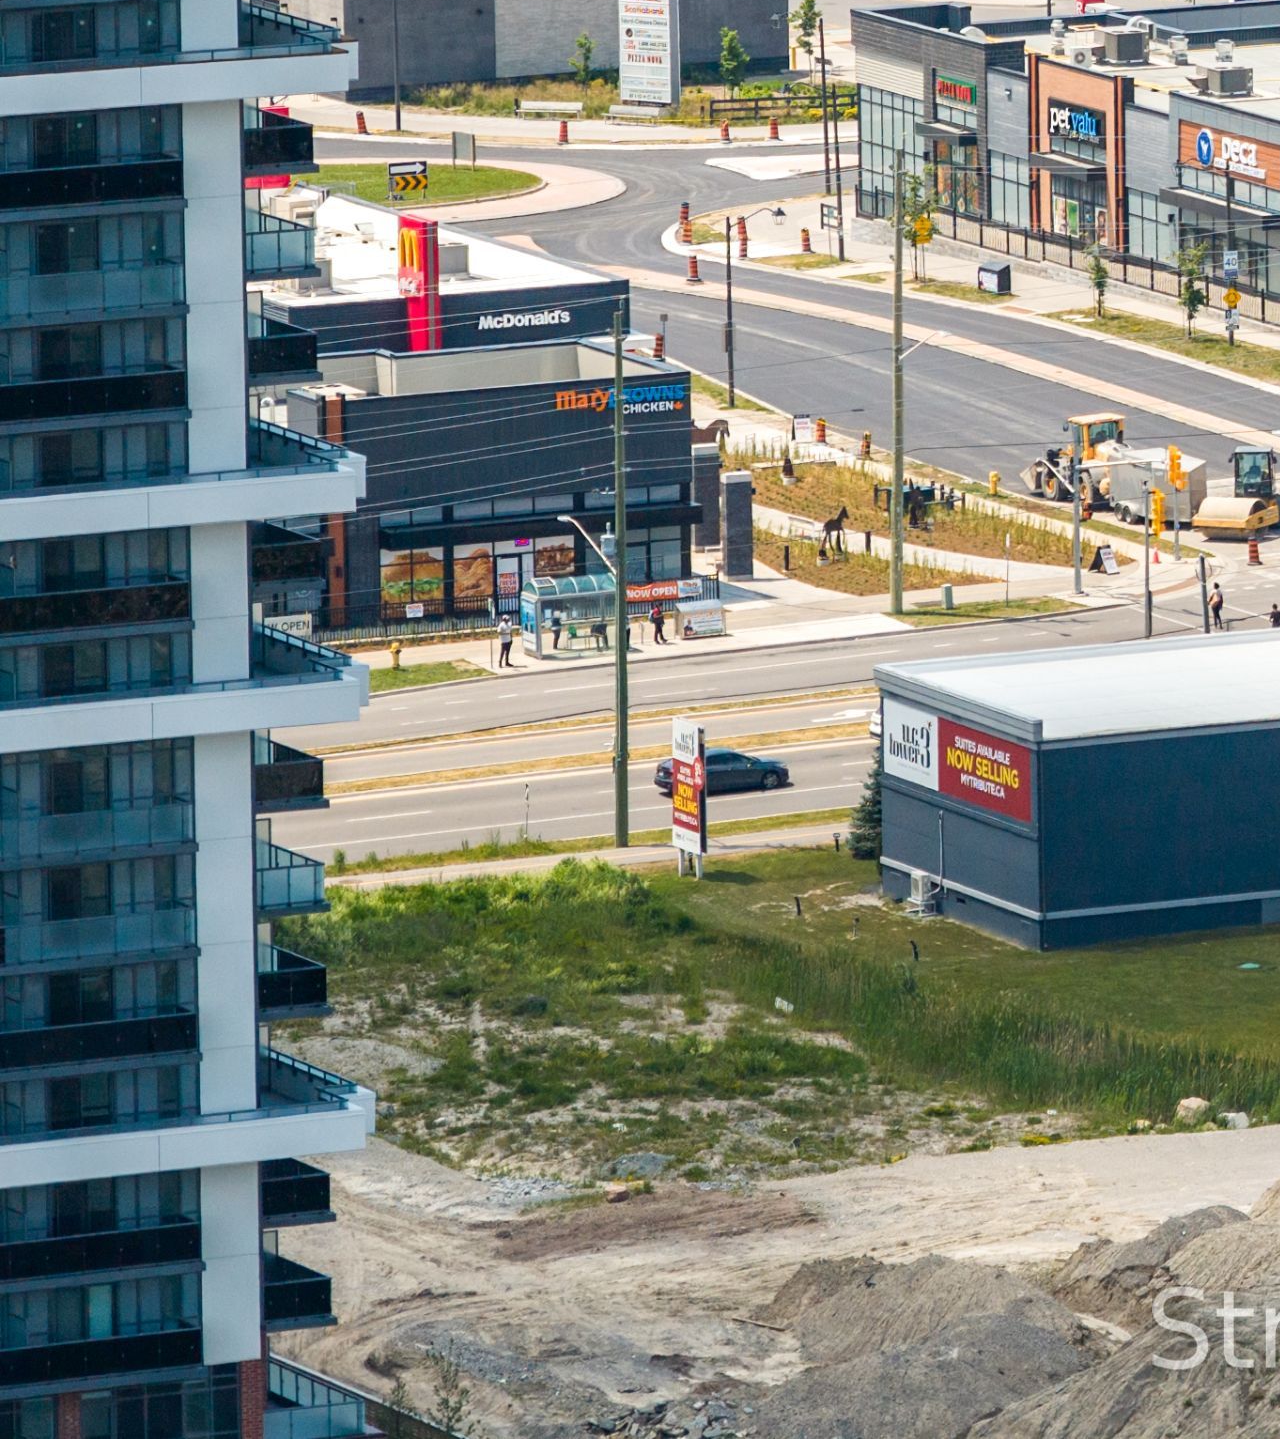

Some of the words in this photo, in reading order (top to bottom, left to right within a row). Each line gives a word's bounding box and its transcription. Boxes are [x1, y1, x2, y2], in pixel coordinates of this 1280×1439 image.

[627, 54, 645, 63] PIZZA
[1050, 107, 1070, 134] pet
[1070, 112, 1097, 136] valu
[1225, 257, 1237, 267] 40
[478, 310, 571, 331] McDonald's
[556, 387, 611, 413] Mary
[622, 401, 674, 414] CHICKEN
[626, 588, 651, 599] NOW
[652, 584, 678, 597] OPEN
[889, 732, 920, 765] tower
[920, 726, 931, 769] 3
[954, 735, 976, 754] SUITES
[976, 742, 1011, 766] AVAILABLE
[946, 746, 974, 773] NOW
[975, 756, 1020, 789] SELLING
[677, 783, 694, 800] NOW
[673, 794, 698, 815] SELLING
